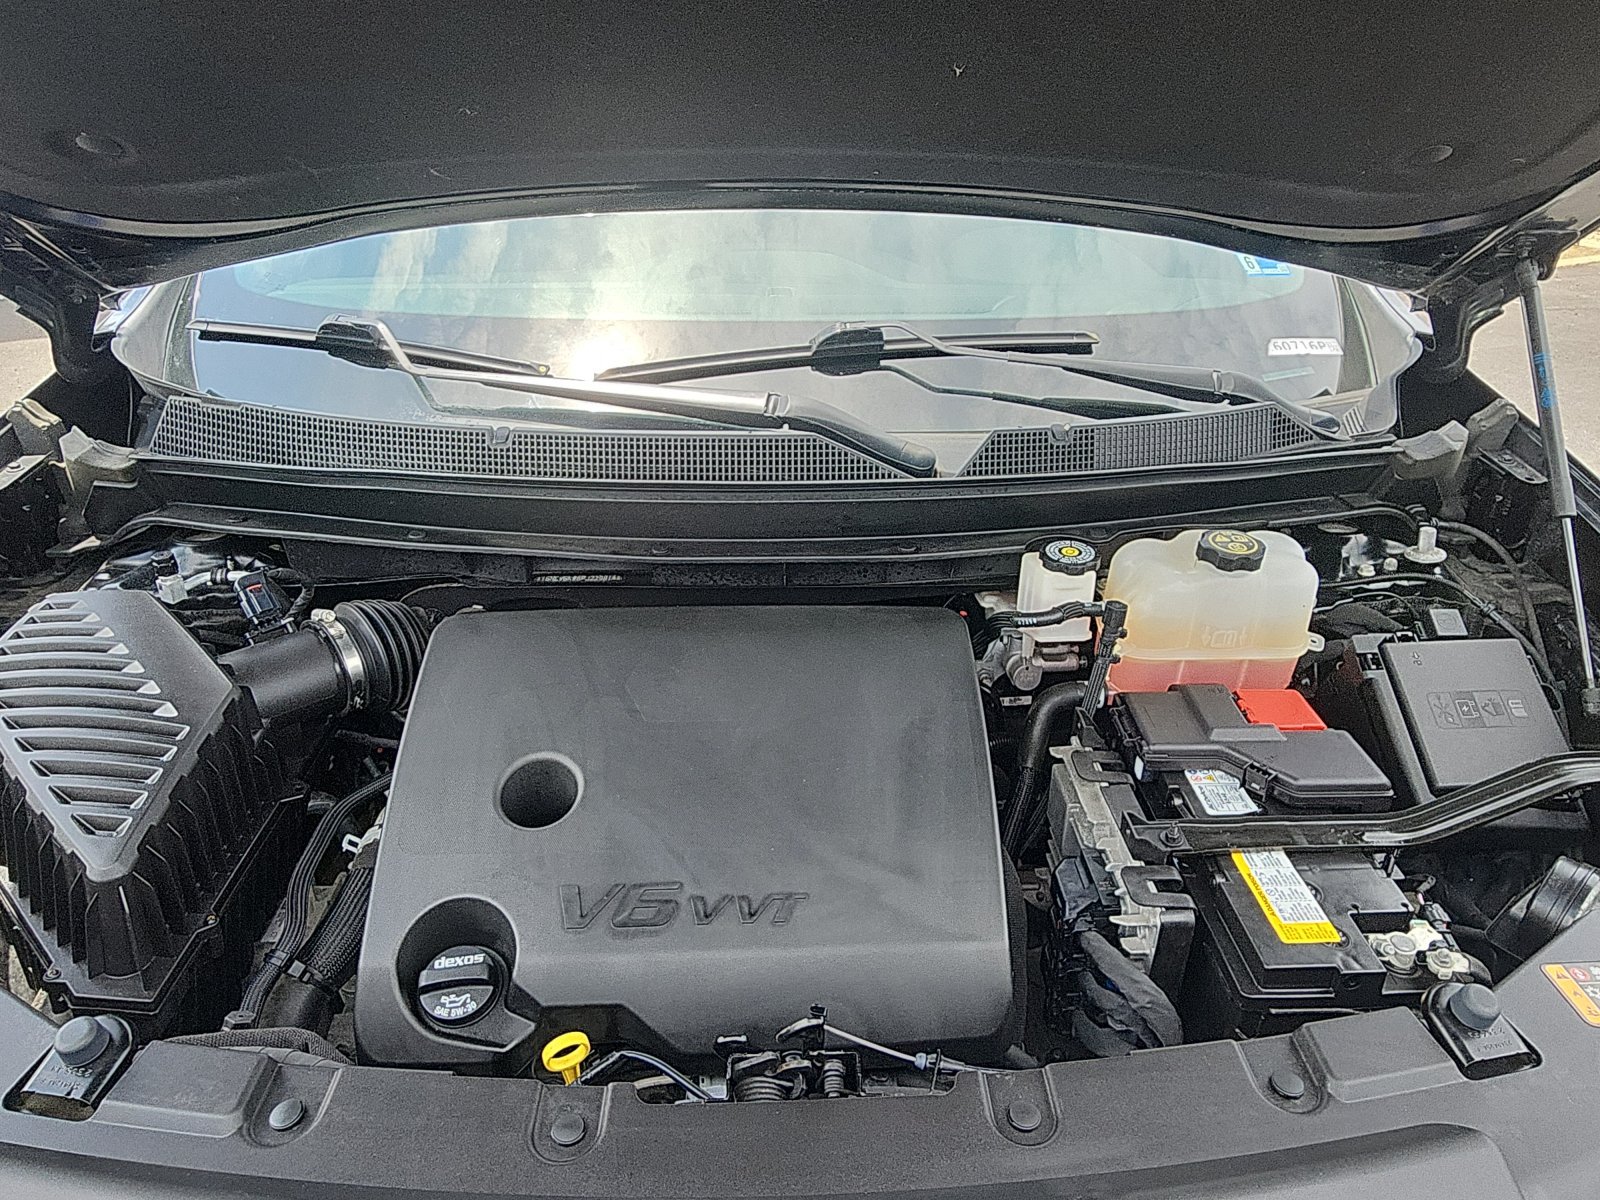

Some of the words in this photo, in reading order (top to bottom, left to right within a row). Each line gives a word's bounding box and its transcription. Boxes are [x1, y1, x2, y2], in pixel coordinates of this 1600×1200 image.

[1244, 256, 1255, 270] 6
[559, 881, 683, 930] V6
[690, 892, 809, 926] VVT
[433, 953, 486, 969] dexos
[434, 1005, 450, 1018] SAE
[451, 1000, 477, 1018] 5W-30
